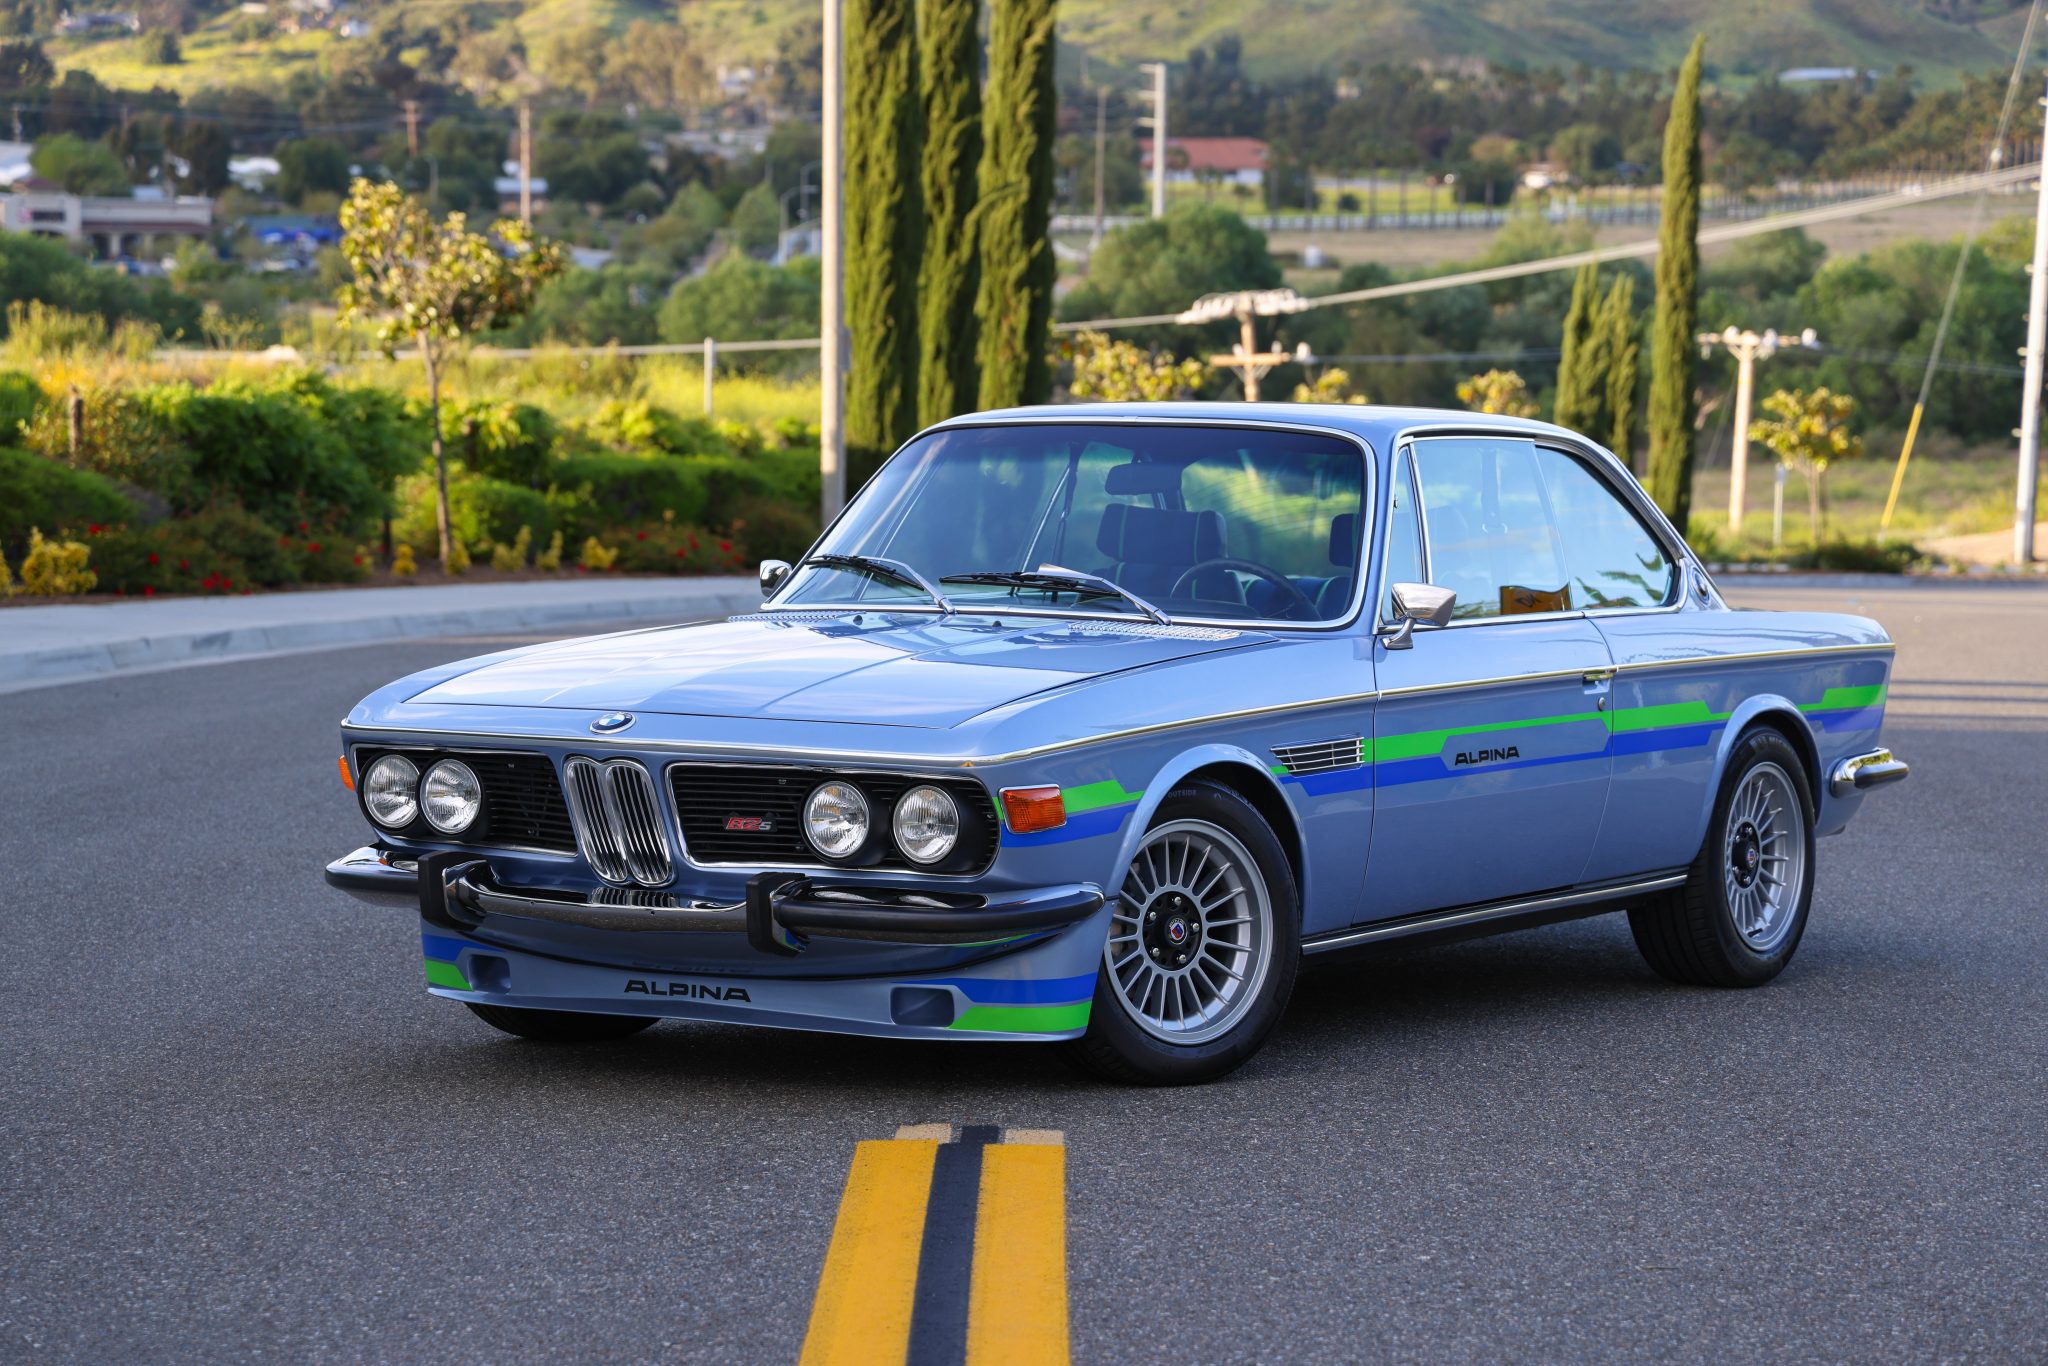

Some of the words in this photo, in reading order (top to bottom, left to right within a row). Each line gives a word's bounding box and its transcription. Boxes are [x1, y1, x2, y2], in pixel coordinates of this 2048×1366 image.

[1454, 746, 1520, 766] ALPINA
[1167, 788, 1197, 799] OUTSIDE
[623, 979, 752, 1003] ALPINA
